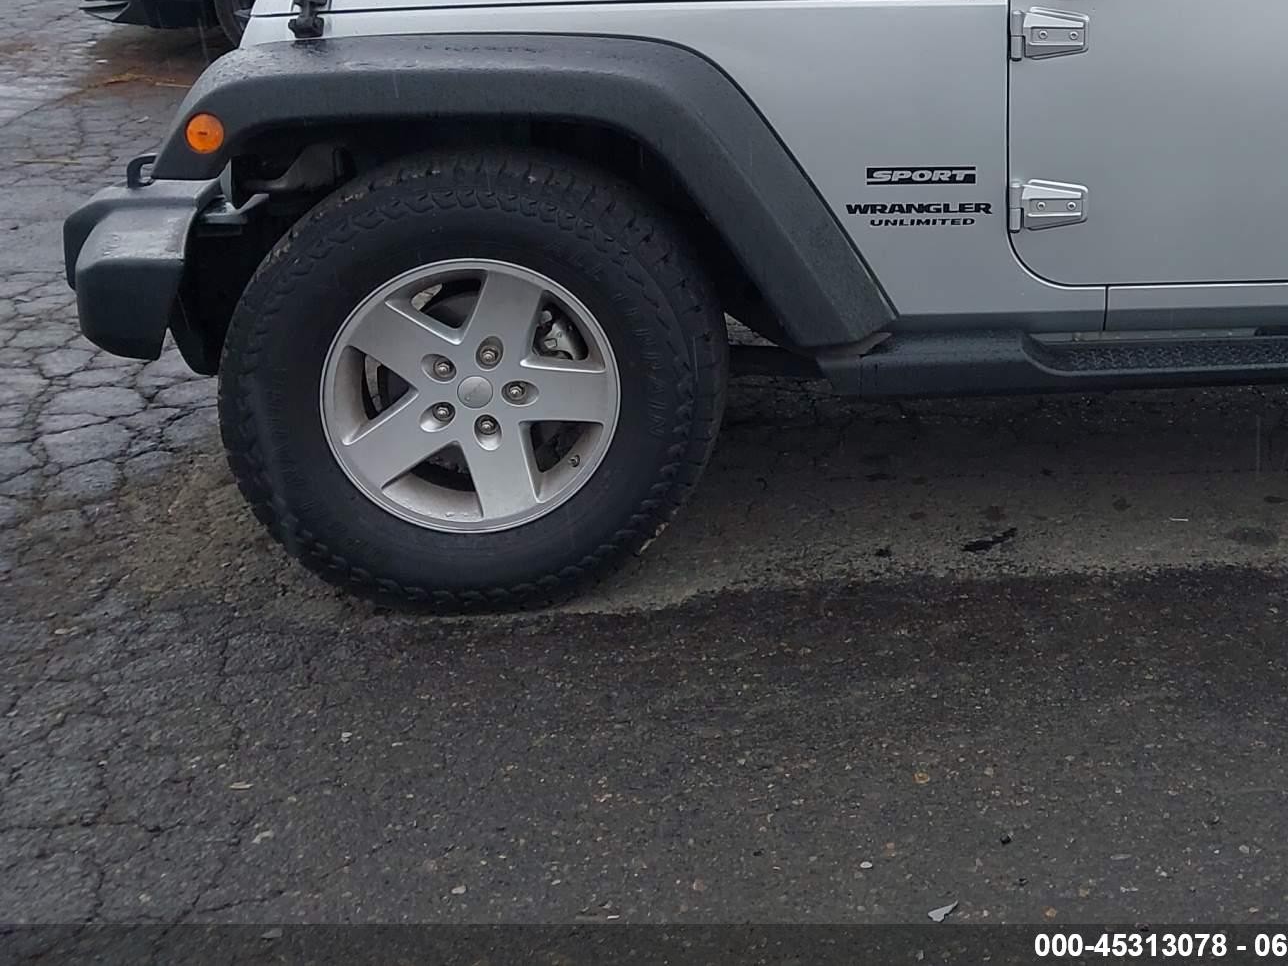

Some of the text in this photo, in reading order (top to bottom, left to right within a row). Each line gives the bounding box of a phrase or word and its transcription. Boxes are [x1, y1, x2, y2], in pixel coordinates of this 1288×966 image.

[867, 169, 976, 182] SPORT
[846, 202, 992, 214] WRANGLER
[870, 218, 975, 226] UNLIMITED
